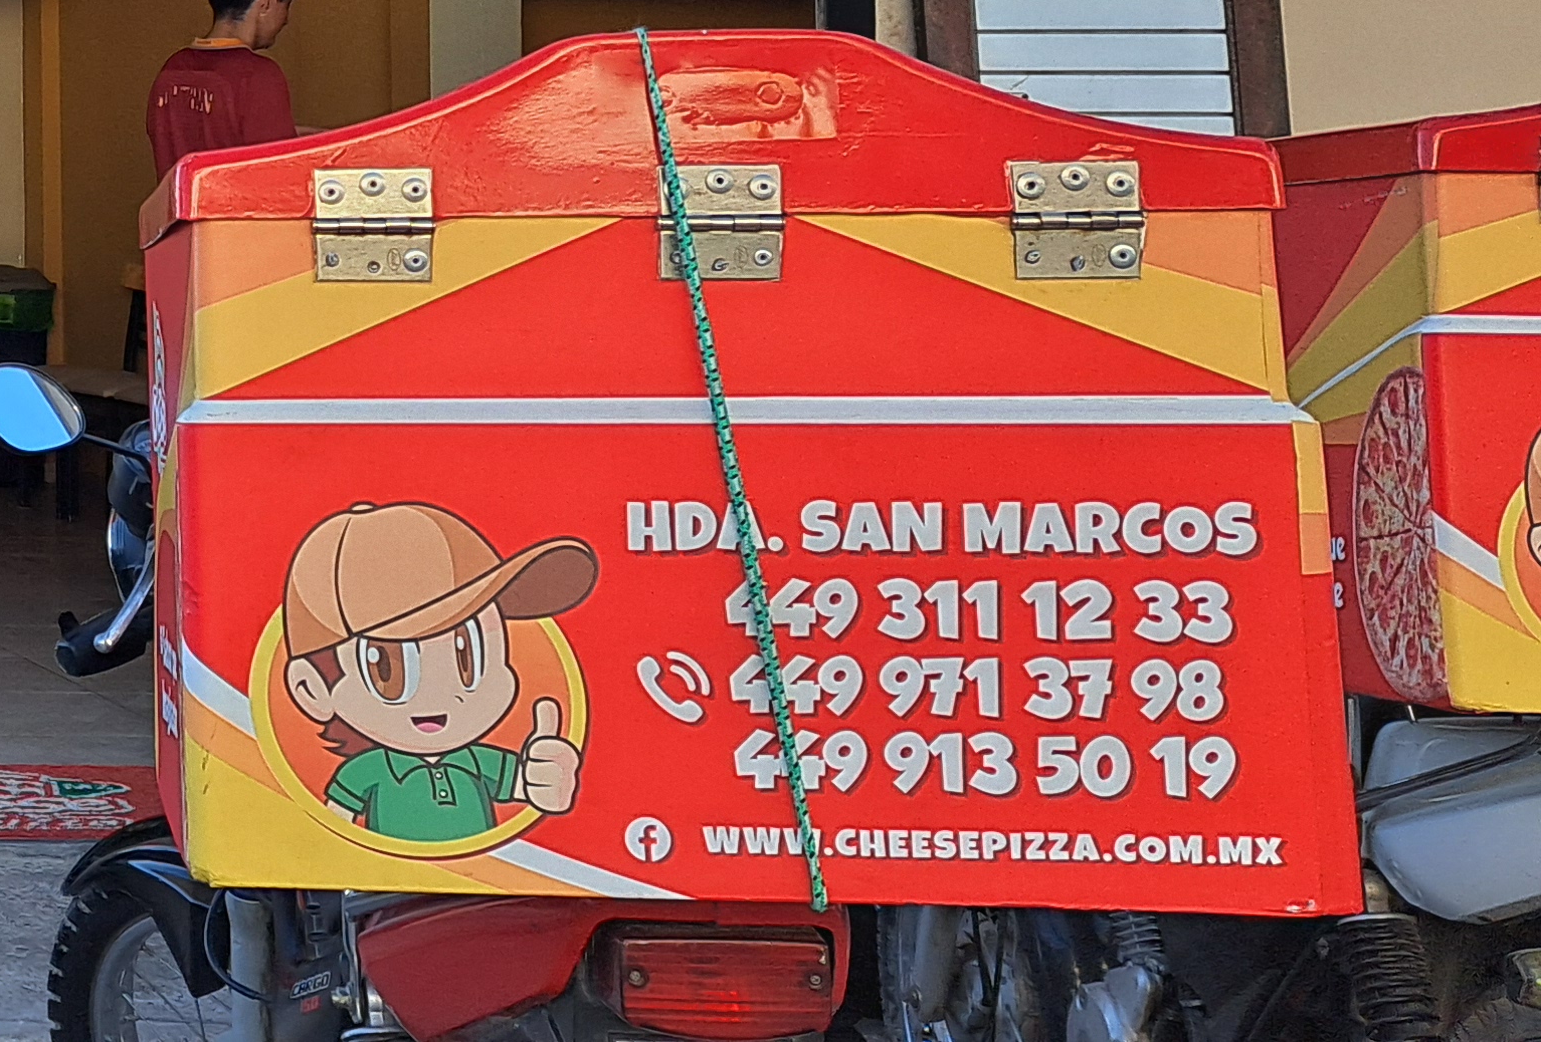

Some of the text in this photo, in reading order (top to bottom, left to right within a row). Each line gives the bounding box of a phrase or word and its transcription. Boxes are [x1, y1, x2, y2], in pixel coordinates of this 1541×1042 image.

[626, 499, 1258, 556] HDA. SAN MARCOS
[725, 577, 1234, 644] 449 311 12 33
[729, 654, 1225, 722] 449 971 37 98
[733, 729, 1237, 800] 449 913 50 19
[703, 825, 1285, 866] WWW.CHEESEPIZZA.COM.MX
